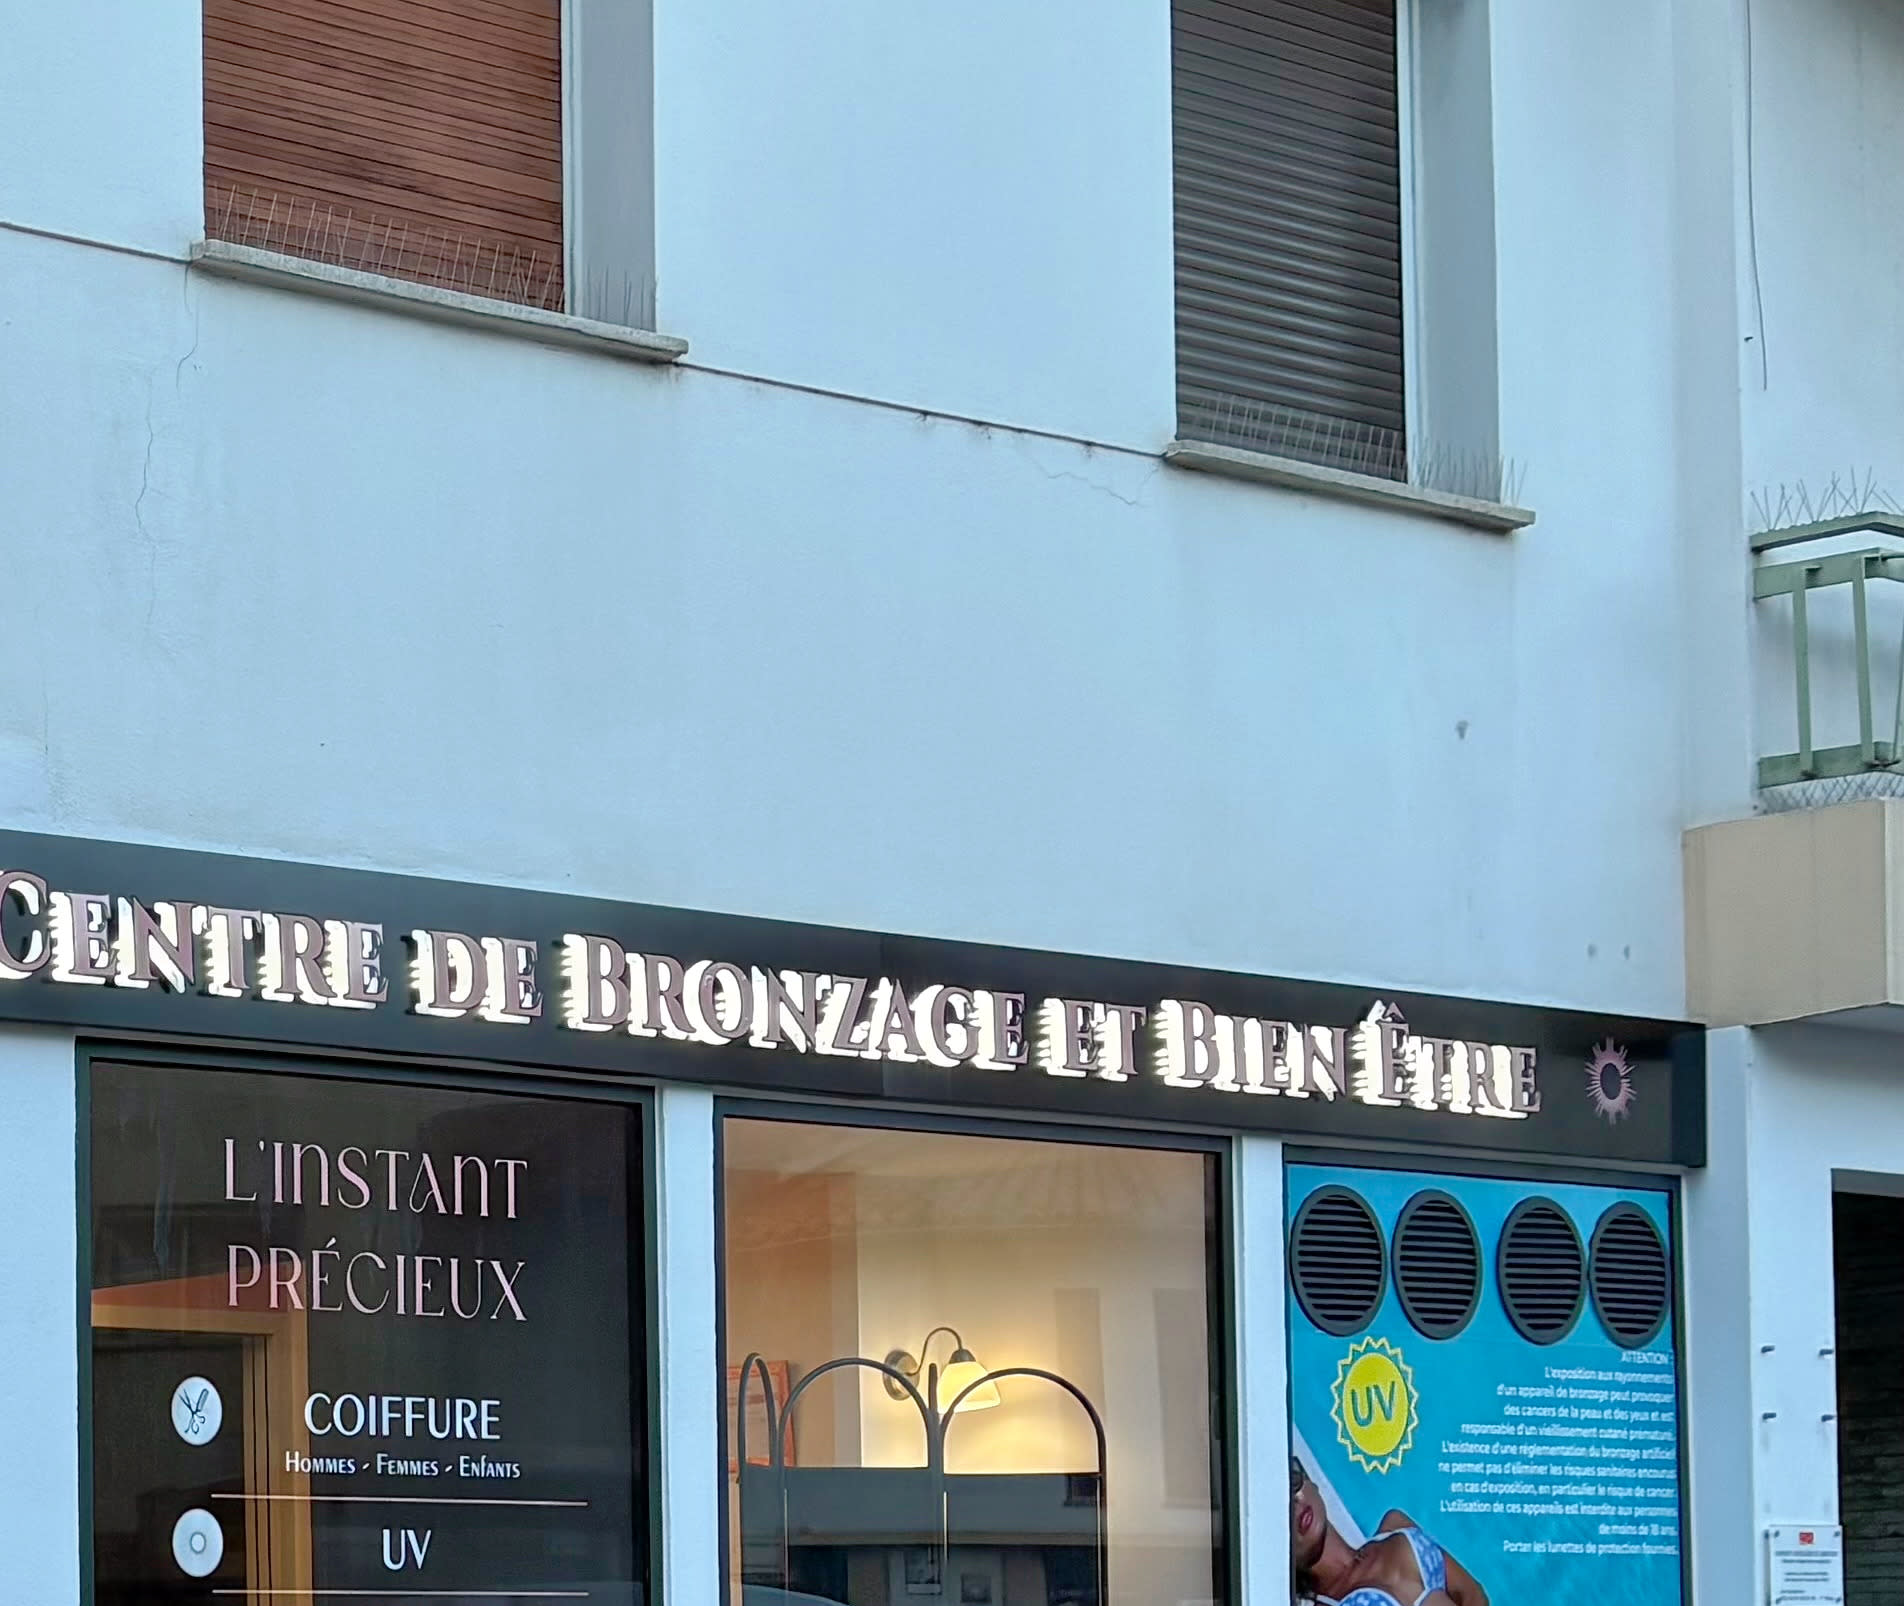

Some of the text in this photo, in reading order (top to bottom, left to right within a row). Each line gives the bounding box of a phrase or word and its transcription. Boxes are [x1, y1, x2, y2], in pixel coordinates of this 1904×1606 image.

[411, 927, 543, 1023] DE
[562, 933, 1029, 1071] BRONZAGE
[1042, 992, 1147, 1080] ET
[1159, 1000, 1344, 1099] BIEN
[1348, 1001, 1541, 1119] ÊTRE
[224, 1138, 527, 1219] L'INSTANT
[227, 1237, 528, 1321] PRÉCIEUX
[304, 1393, 501, 1440] COIFFURE
[1351, 1380, 1398, 1427] UV
[381, 1528, 431, 1570] UV
